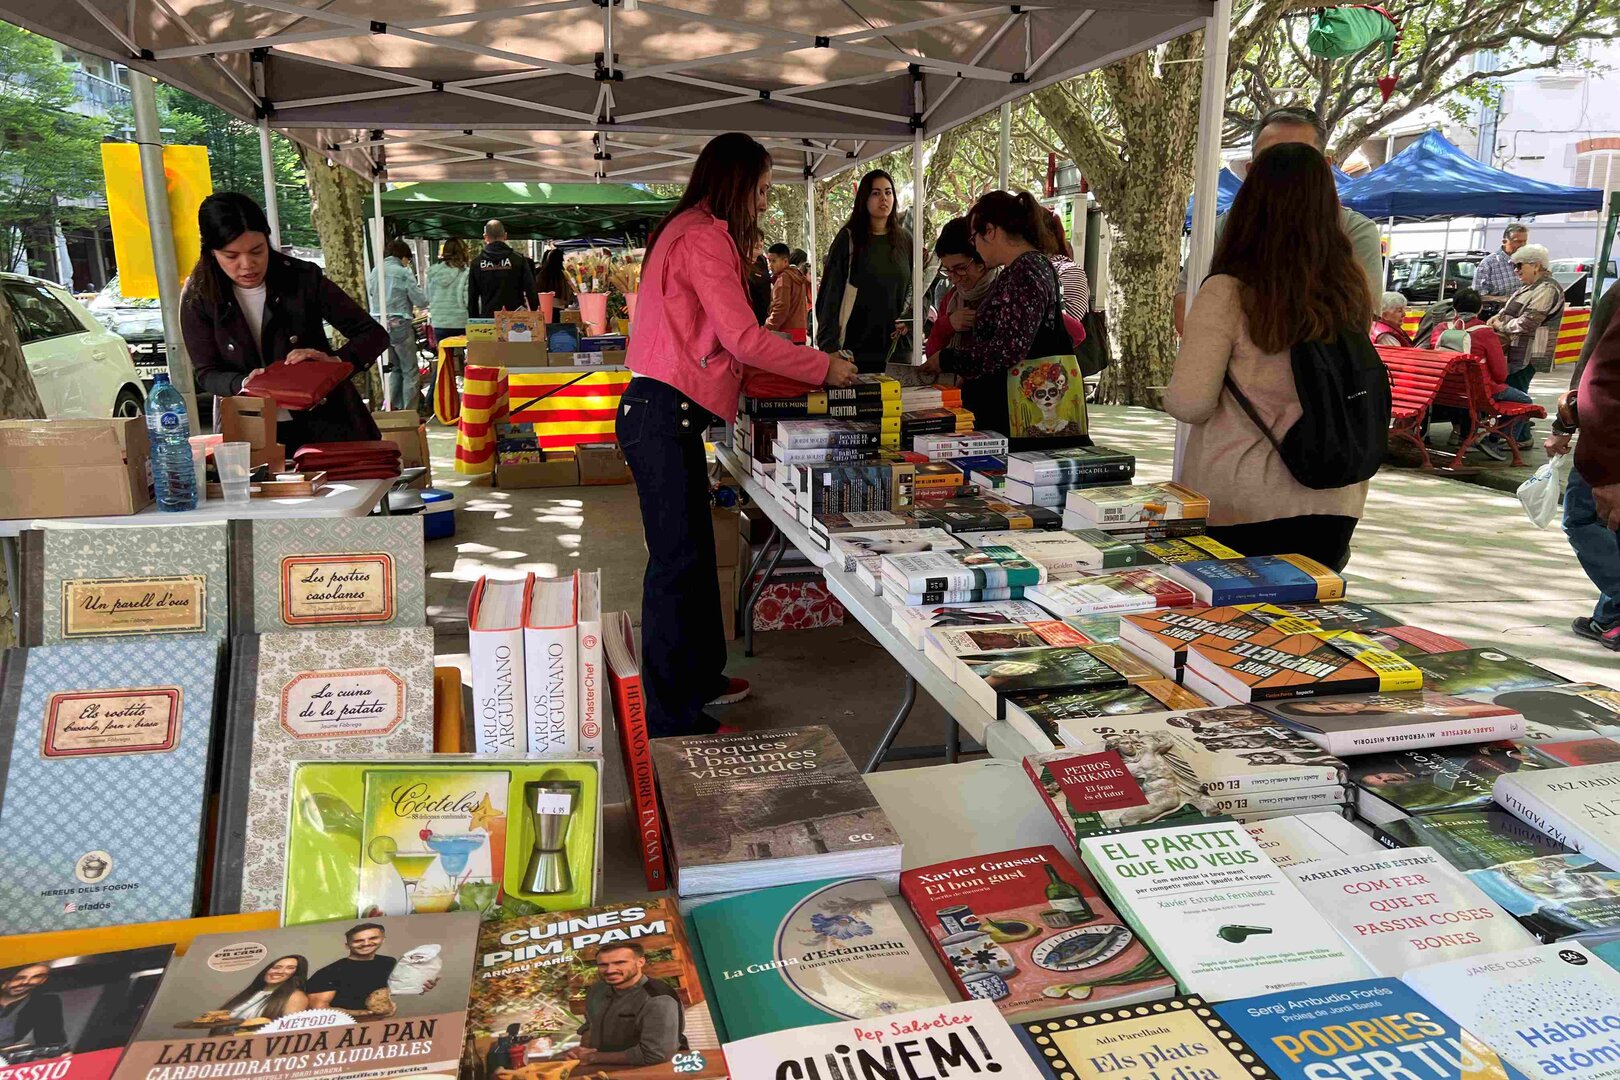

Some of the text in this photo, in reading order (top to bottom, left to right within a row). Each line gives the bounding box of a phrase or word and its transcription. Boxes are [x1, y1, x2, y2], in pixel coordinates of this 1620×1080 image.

[829, 388, 856, 400] MENTIRA
[830, 406, 857, 416] MENTIRA
[301, 568, 370, 588] Les postres
[306, 584, 365, 601] casolanes
[80, 592, 189, 615] Un parell d'ous
[1157, 613, 1255, 641] IMPACTE
[1228, 642, 1337, 678] IMPACTE
[311, 683, 373, 699] La cuina
[494, 645, 515, 748] ARGUIÑANO
[546, 643, 565, 745] ARGUIÑANO
[585, 662, 595, 721] MasterChef
[79, 702, 152, 719] Els rostits
[299, 699, 387, 721] de la patata
[1353, 737, 1385, 745] HISTORIA
[1386, 733, 1426, 742] VERDADERA
[1440, 728, 1471, 737] PREYSLER
[685, 741, 788, 757] Roques
[688, 749, 817, 768] i baumes
[626, 684, 660, 863] HERMANOS TORRES EN CASA
[689, 759, 817, 779] viscudes
[1064, 761, 1111, 776] PETROS
[1085, 784, 1114, 793] El frau
[1104, 790, 1124, 798] futur
[1228, 780, 1240, 790] EL
[1547, 781, 1579, 792] PAZ
[391, 783, 480, 817] Cócteles
[1235, 799, 1248, 810] EL
[1505, 793, 1567, 845] PADILLA PAZ
[1100, 844, 1139, 862] EL
[1149, 829, 1242, 856] PARTIT
[918, 854, 1049, 884] Xavier Grasset
[1115, 849, 1260, 879] QUE NO VEUS
[1299, 854, 1438, 883] MARIAN ROJAS ESTAPÉ
[925, 869, 1026, 895] El bon gust
[1149, 883, 1182, 893] competir
[1182, 880, 1205, 888] millor
[1211, 877, 1233, 886] gaudir
[1170, 874, 1200, 883] entrenar
[1209, 870, 1226, 878] teva
[1343, 874, 1431, 895] COM FER
[41, 882, 140, 898] HEREUS DELS FOGONS
[1157, 899, 1188, 909] Xavier
[1189, 893, 1226, 905] Estrada
[1369, 892, 1440, 912] QUE ET
[501, 907, 646, 945] CUINES
[1353, 907, 1495, 936] PASSIN COSES
[483, 920, 667, 967] PIM PAM
[1409, 931, 1481, 951] BONES
[722, 941, 905, 981] La Cuina d'Estamariu
[829, 956, 851, 964] mica
[853, 953, 864, 961] de
[866, 949, 909, 959] Bescaran)
[1466, 956, 1544, 977] JAMES CLEAR
[482, 963, 529, 979] ARNAU
[1247, 985, 1394, 1018] Sergi Ambudio Forés
[1315, 1009, 1329, 1018] de
[1330, 1004, 1352, 1015] Jordi
[854, 1013, 973, 1043] Pep Salsetes
[1096, 1026, 1171, 1046] Ada Parellada
[1271, 1011, 1447, 1064] PODRIES
[155, 1018, 438, 1065] LARGA VIDA AL PAN
[146, 1041, 433, 1080] CARBOHIDRATOS SALUDABLES
[1089, 1041, 1209, 1073] Els plats
